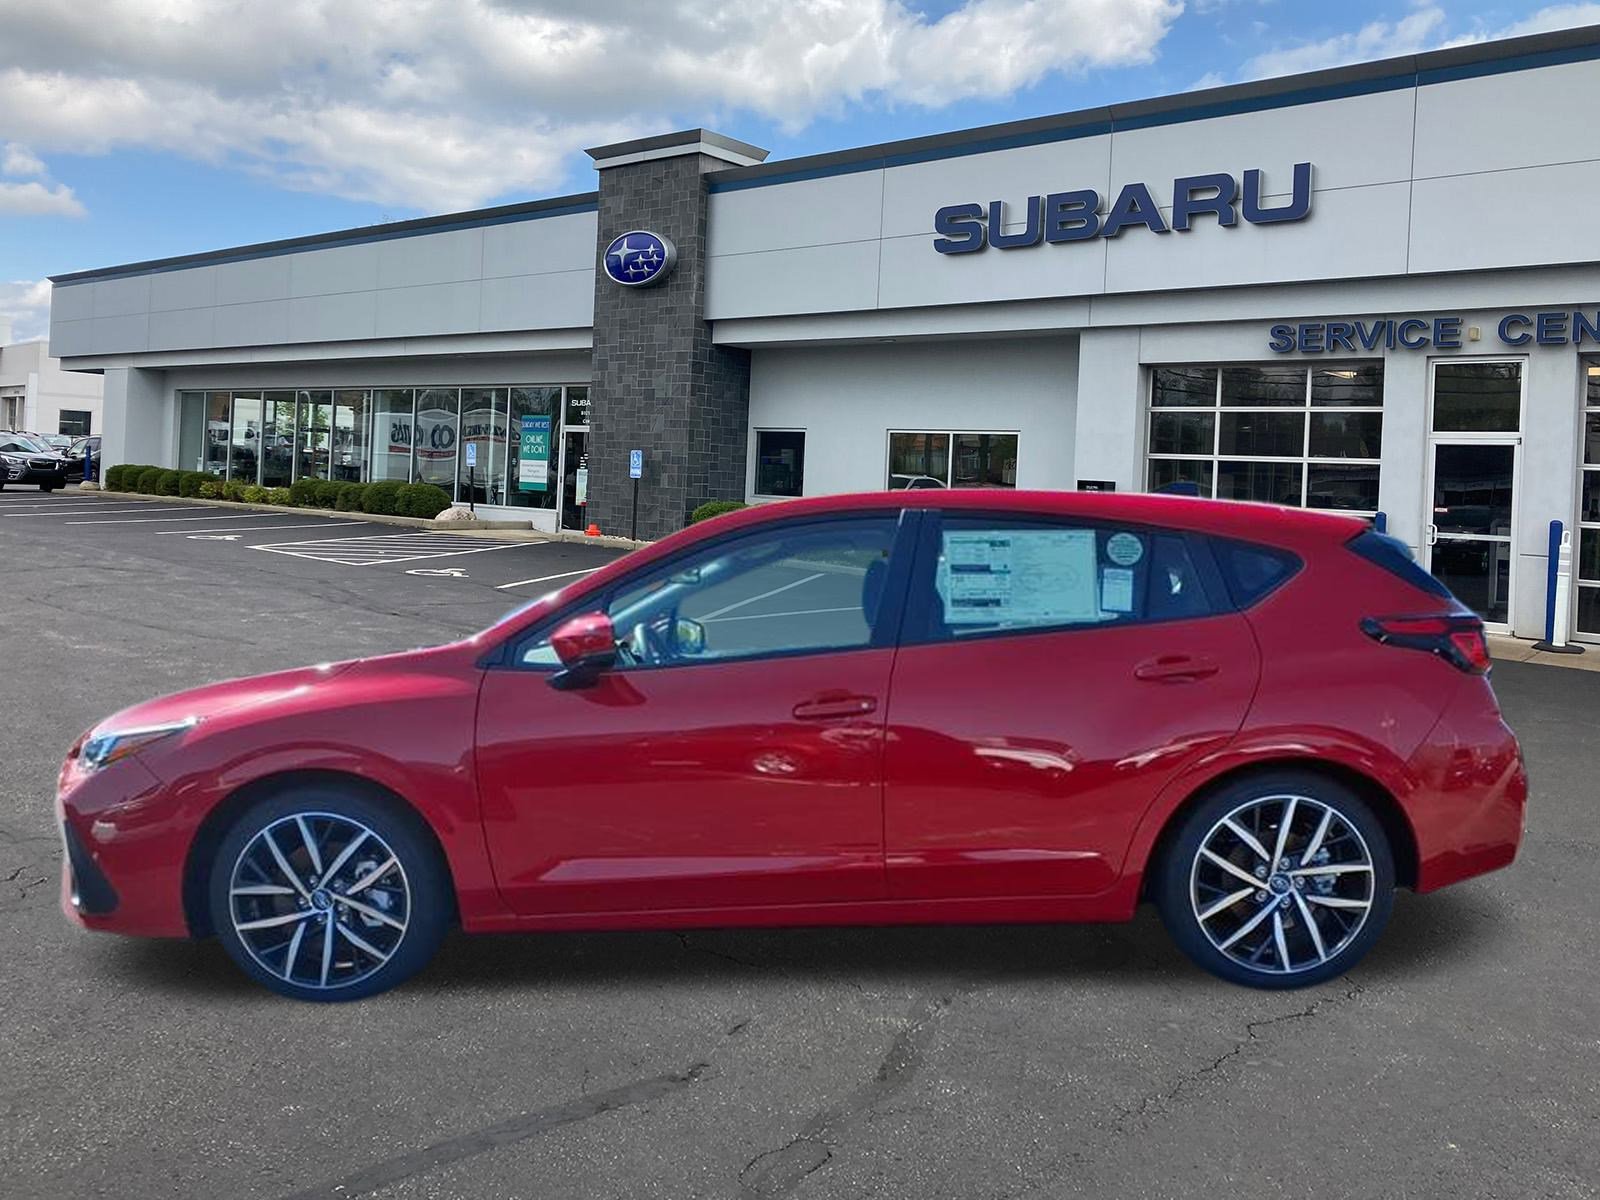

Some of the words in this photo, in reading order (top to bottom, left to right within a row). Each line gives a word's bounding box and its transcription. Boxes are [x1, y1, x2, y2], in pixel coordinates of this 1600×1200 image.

[933, 161, 1314, 255] SUBARU
[1268, 317, 1463, 353] SERVICE
[1497, 311, 1600, 346] CEN
